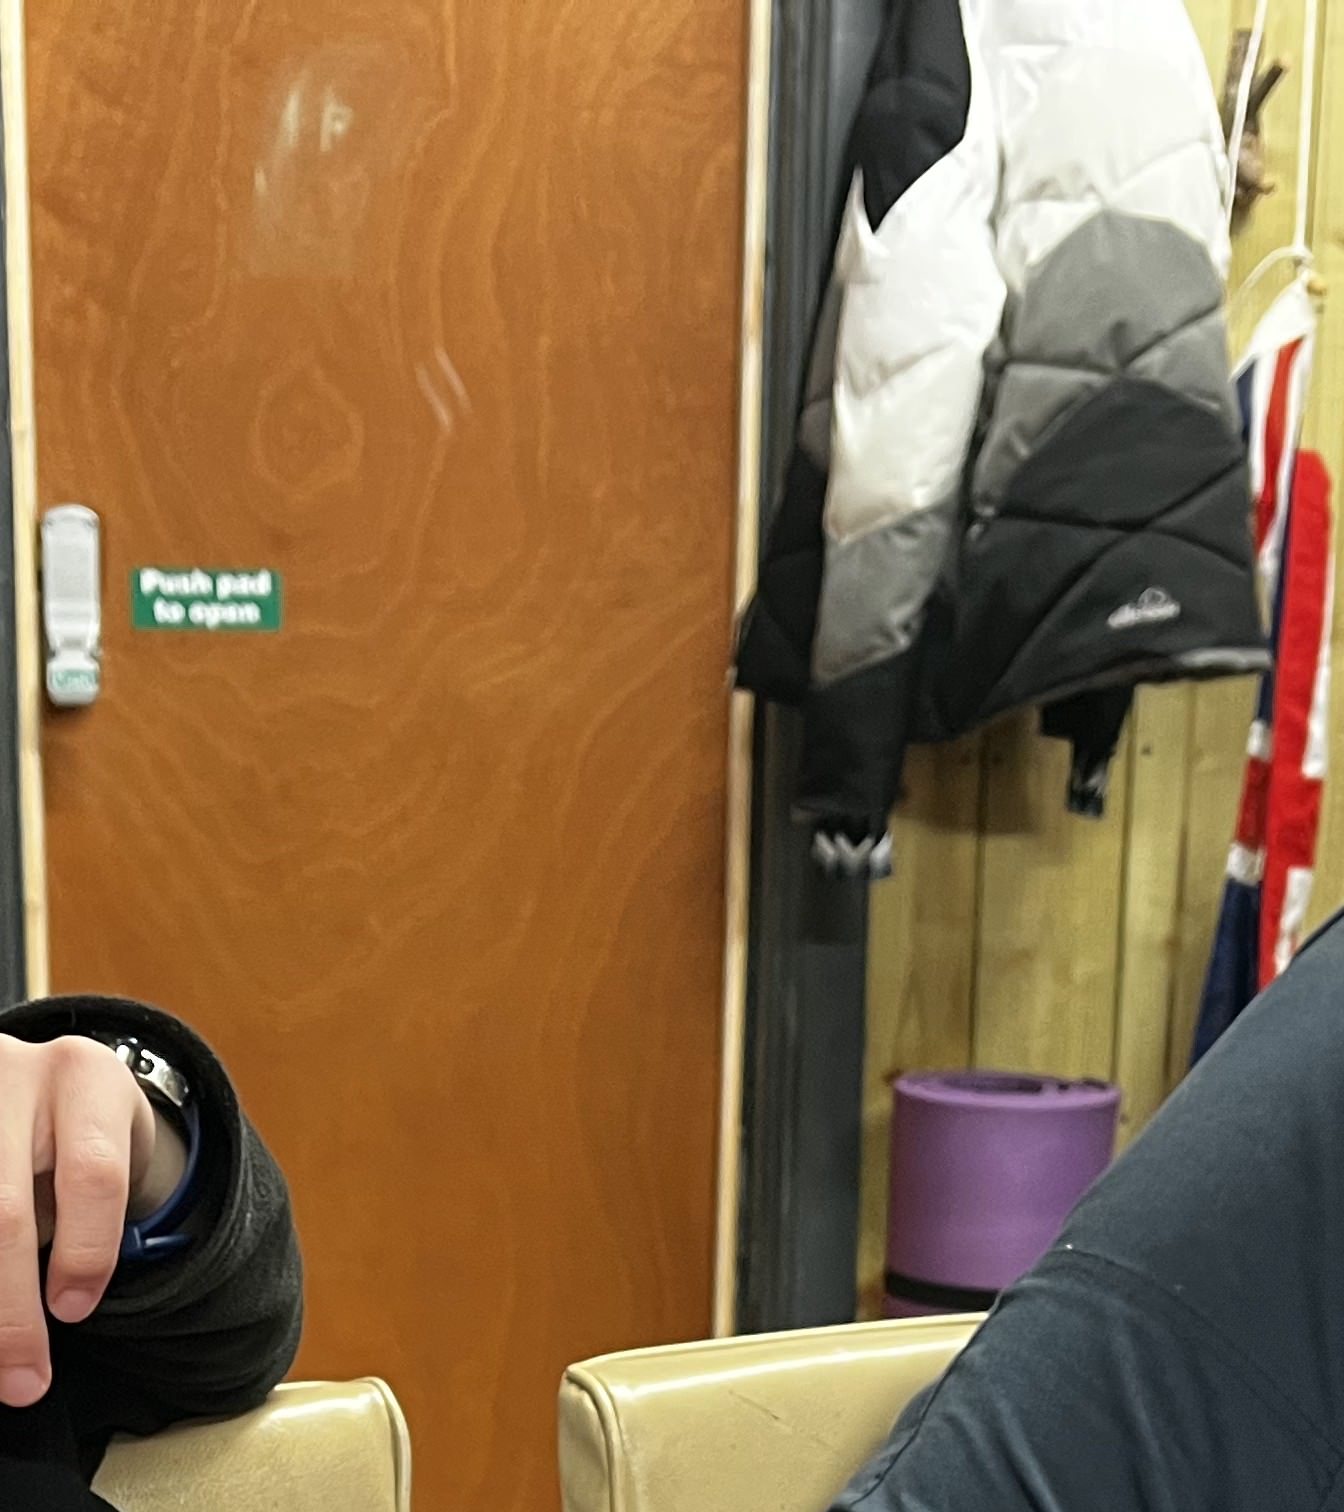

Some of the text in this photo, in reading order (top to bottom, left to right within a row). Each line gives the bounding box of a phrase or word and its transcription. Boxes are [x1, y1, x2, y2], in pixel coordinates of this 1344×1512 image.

[140, 567, 272, 600] Push pad
[153, 597, 261, 631] to open
